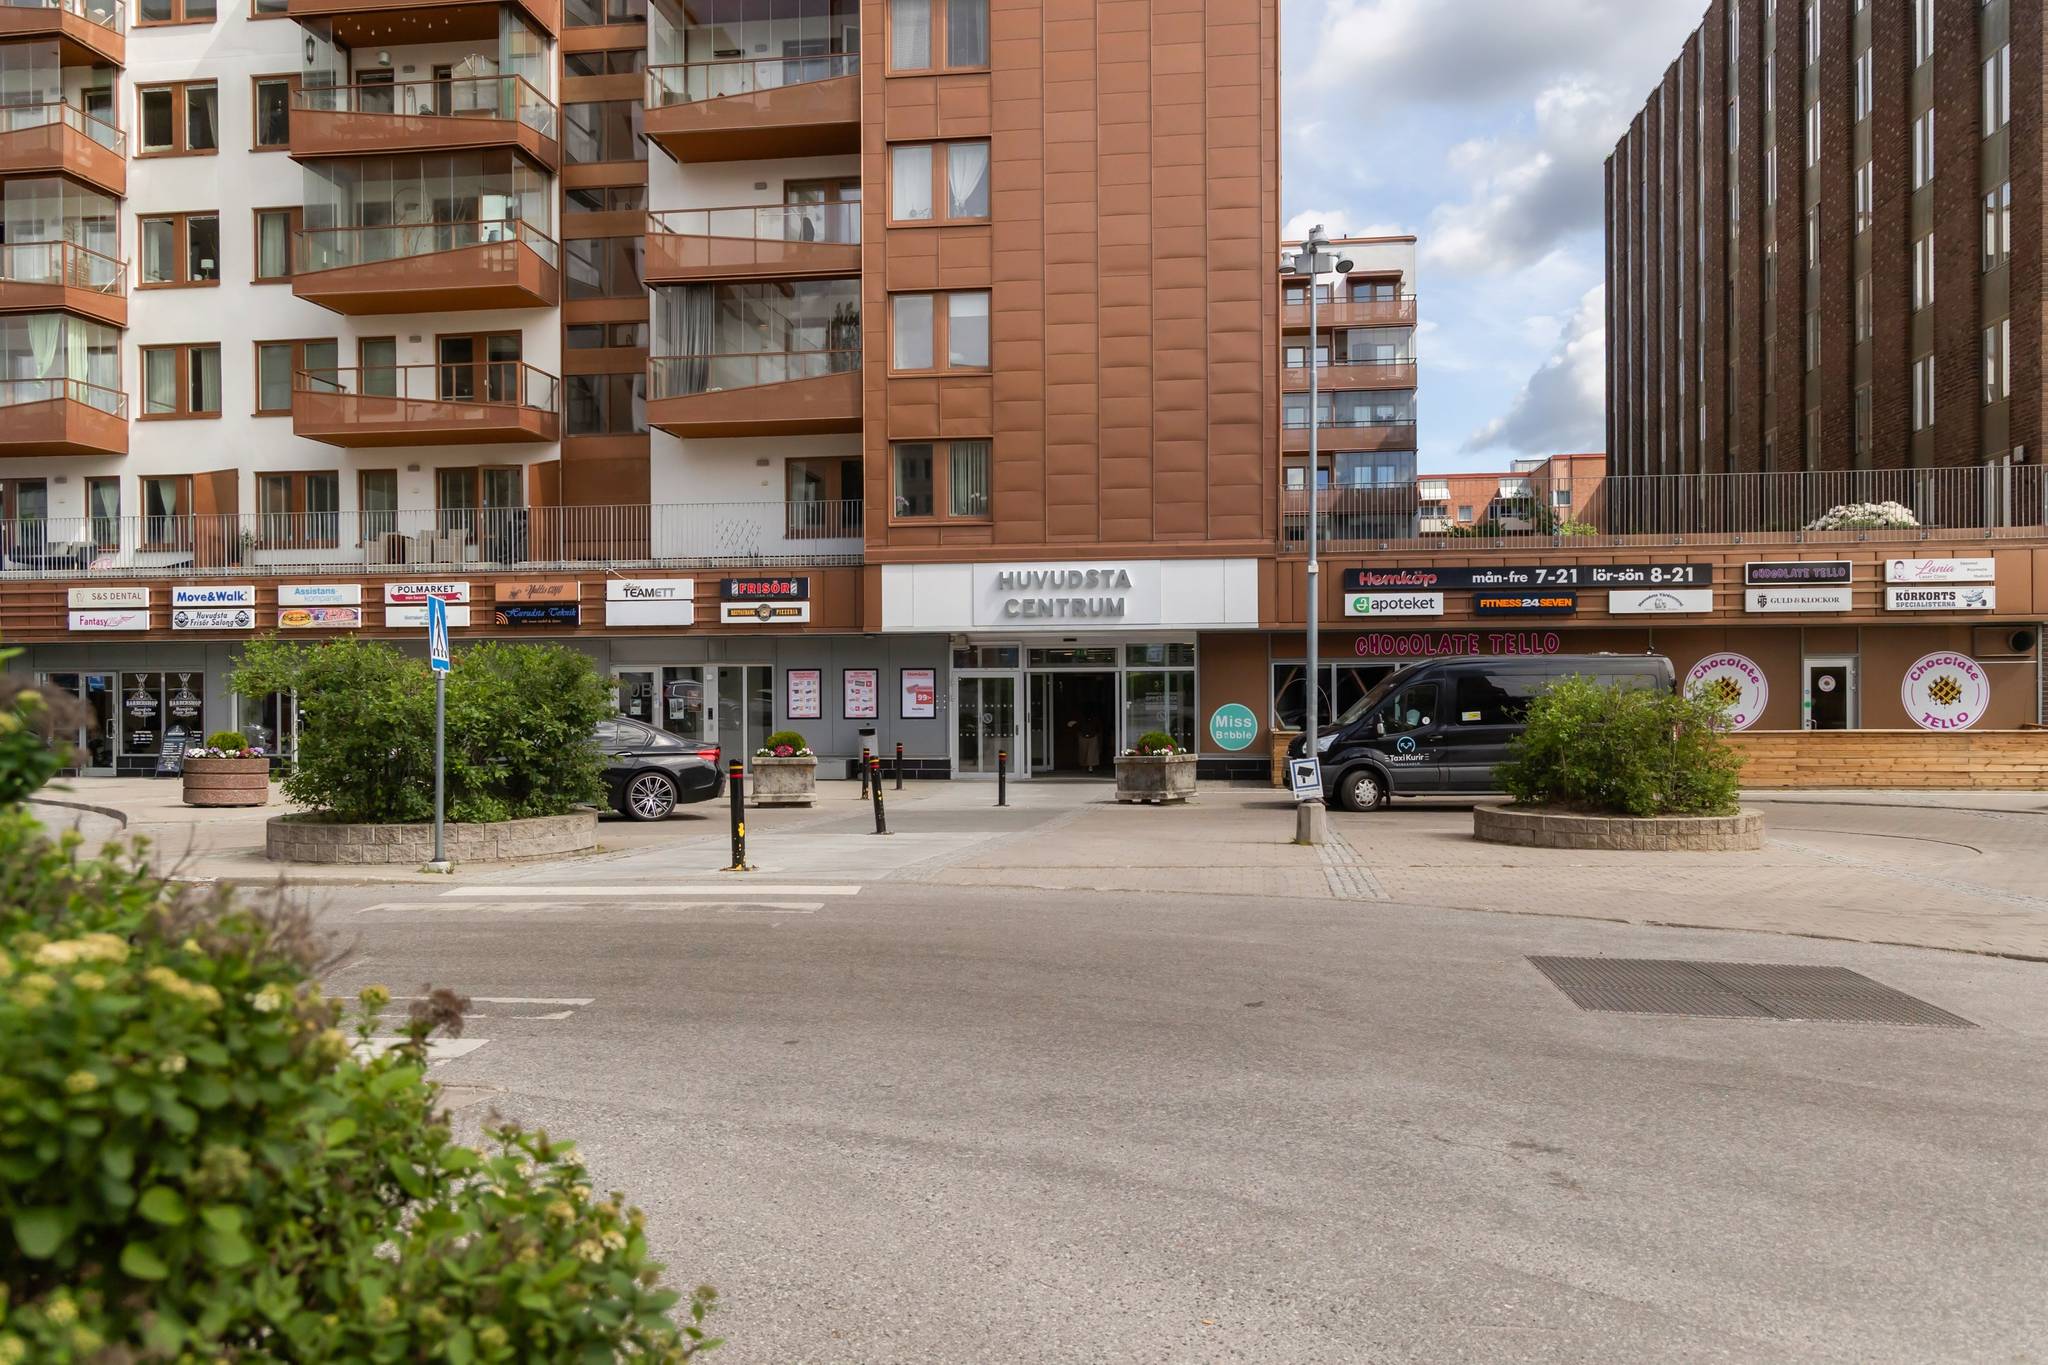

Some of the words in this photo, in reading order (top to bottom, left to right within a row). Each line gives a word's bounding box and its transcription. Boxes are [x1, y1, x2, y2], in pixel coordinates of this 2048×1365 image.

[1359, 571, 1437, 587] Hemköp
[1472, 571, 1528, 583] mån-fre
[1535, 568, 1577, 584] 7-21
[1592, 568, 1644, 581] lör-sön
[1650, 567, 1694, 582] 8-21
[1752, 568, 1810, 578] CHOCOLATE
[1813, 567, 1846, 578] TELLO
[998, 569, 1132, 590] HUVUDSTA
[294, 587, 336, 595] Assistans
[397, 585, 455, 593] POLMARKET
[740, 580, 790, 594] FRISÖR
[92, 592, 108, 600] S&S
[110, 592, 142, 600] DENTAL
[177, 591, 244, 602] Move&Walk
[1895, 590, 1956, 601] KÖRKORTS
[1004, 598, 1125, 617] CENTRUM
[1371, 597, 1435, 612] apoteket
[1480, 598, 1572, 608] FITNESS24SEVEN
[79, 615, 108, 627] Fantasy
[196, 611, 228, 619] Huvudsta
[211, 619, 234, 627] Salong
[1355, 633, 1480, 656] CHOCOLATE
[1488, 633, 1560, 655] TELLO
[1693, 658, 1759, 684] Chocolate
[1910, 657, 1979, 681] Chocolate
[1215, 715, 1252, 728] Miss
[1922, 712, 1969, 729] TELLO
